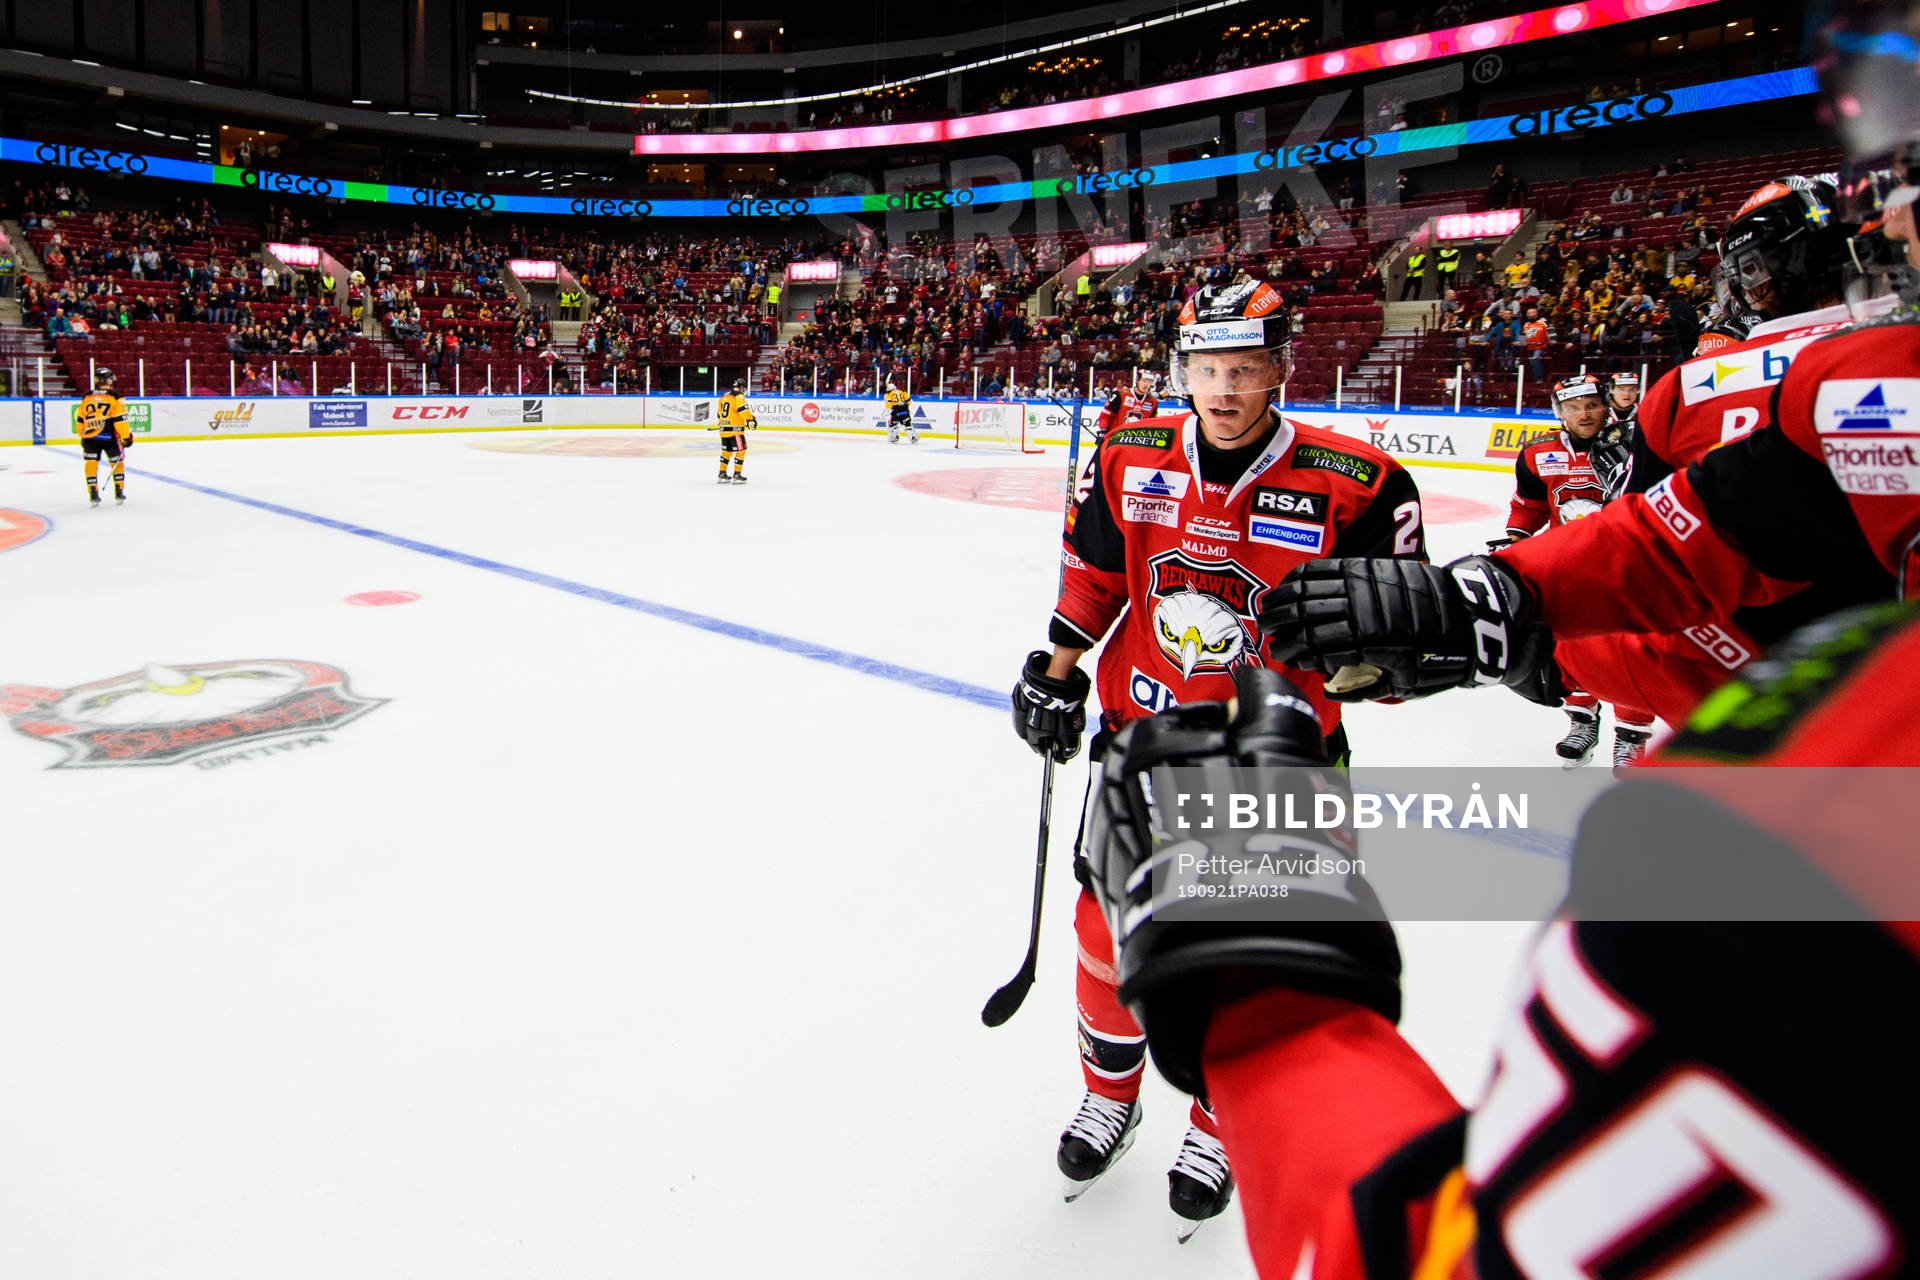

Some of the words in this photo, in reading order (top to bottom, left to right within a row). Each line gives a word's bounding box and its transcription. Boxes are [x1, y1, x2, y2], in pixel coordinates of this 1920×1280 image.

[1509, 90, 1673, 138] areco
[36, 142, 148, 175] areco
[1254, 135, 1377, 170] areco
[240, 168, 332, 197] areco
[1056, 165, 1155, 197] areco
[412, 186, 495, 212] areco
[571, 196, 652, 218] areco
[727, 196, 809, 217] areco
[886, 187, 974, 211] areco
[1728, 232, 1753, 250] CCM
[1200, 307, 1235, 316] CCM
[1206, 332, 1262, 341] MAGNUSSON
[34, 402, 42, 436] CCM
[85, 403, 111, 419] 27
[208, 402, 255, 431] guld
[392, 405, 469, 419] CCM
[750, 404, 792, 414] VOLITO
[1119, 435, 1158, 446] HUSET
[1369, 432, 1457, 456] RASTA
[1493, 425, 1544, 449] BLÅ
[1250, 453, 1275, 476] bergx
[1313, 457, 1361, 478] HUSET
[1137, 481, 1176, 490] ERLANDSSON
[1204, 483, 1230, 495] SHL
[1257, 492, 1315, 514] RSA
[1133, 510, 1168, 524] Finans
[1192, 515, 1232, 528] CCM
[1193, 526, 1239, 539] MonkeySports
[1256, 526, 1316, 543] EHRENBORG
[1181, 539, 1228, 557] MALMÖ
[1158, 563, 1247, 609] REDHAWKS
